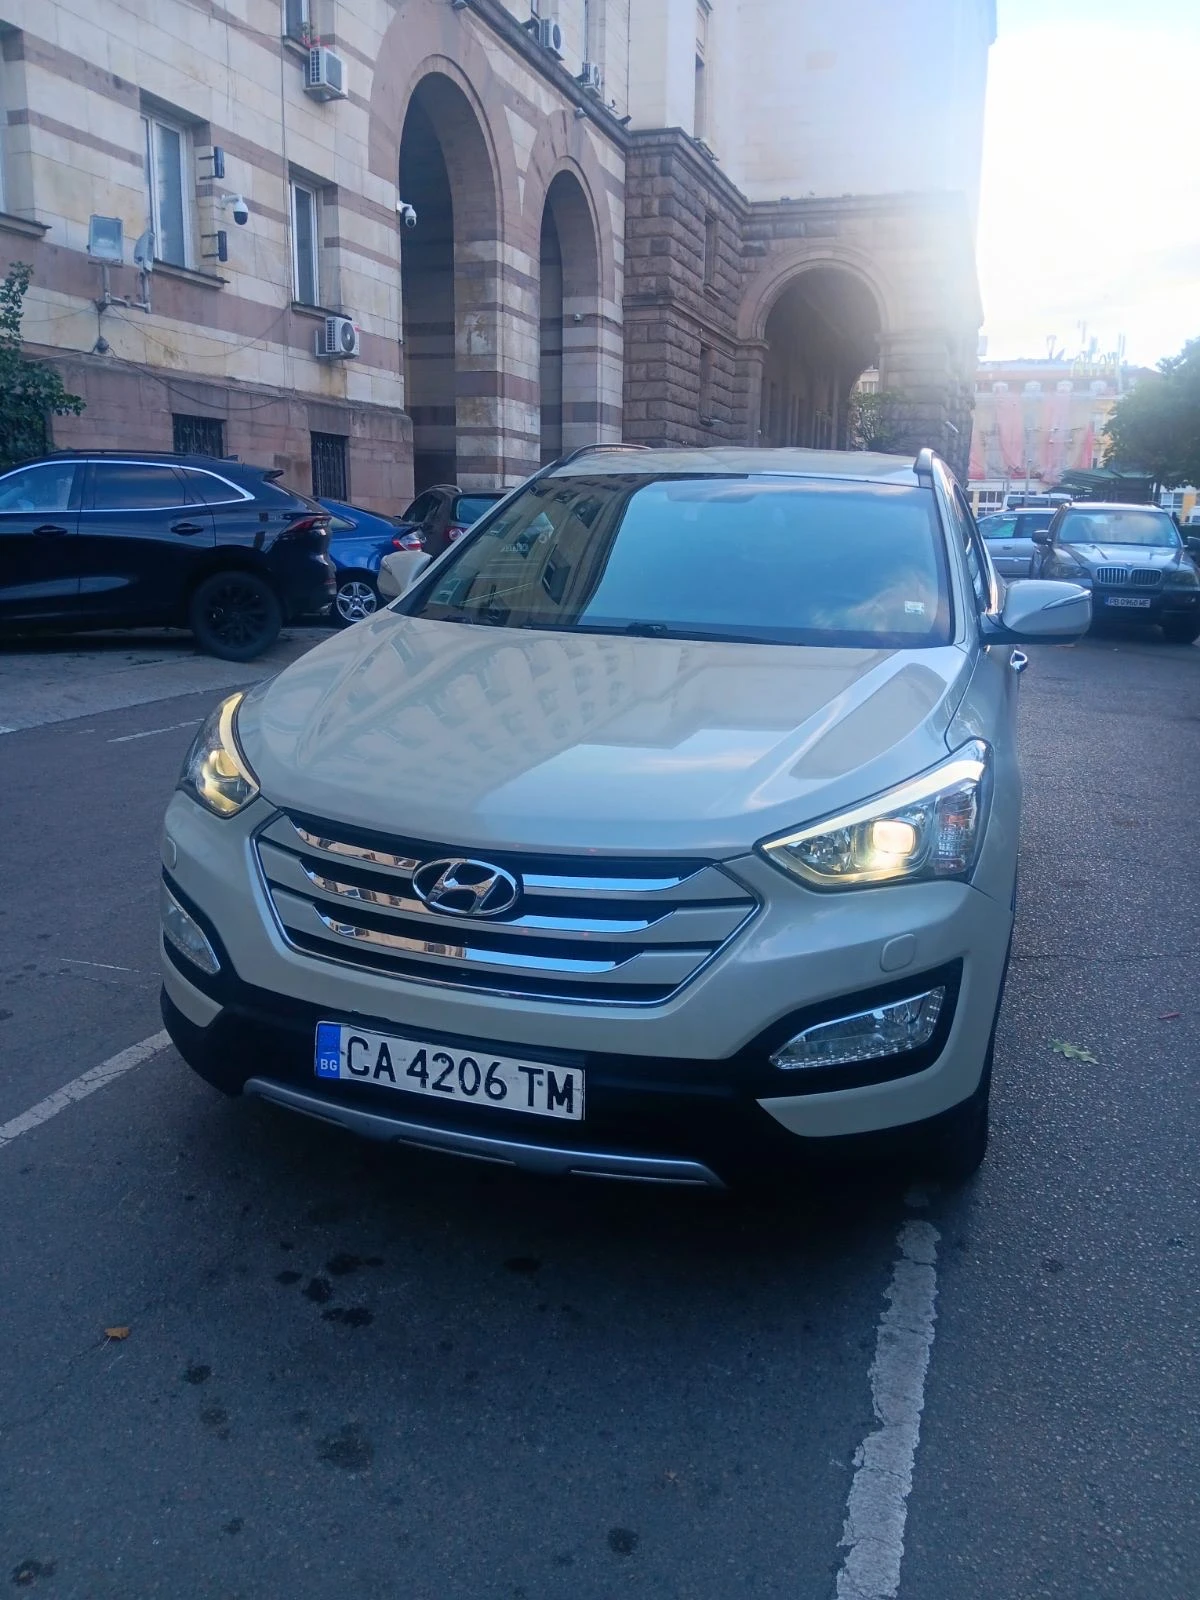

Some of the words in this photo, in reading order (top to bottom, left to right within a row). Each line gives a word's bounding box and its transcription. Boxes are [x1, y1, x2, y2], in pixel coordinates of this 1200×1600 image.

[320, 1058, 338, 1071] BG
[347, 1035, 396, 1083] CA
[406, 1048, 508, 1101] 4206
[518, 1065, 574, 1114] TM
